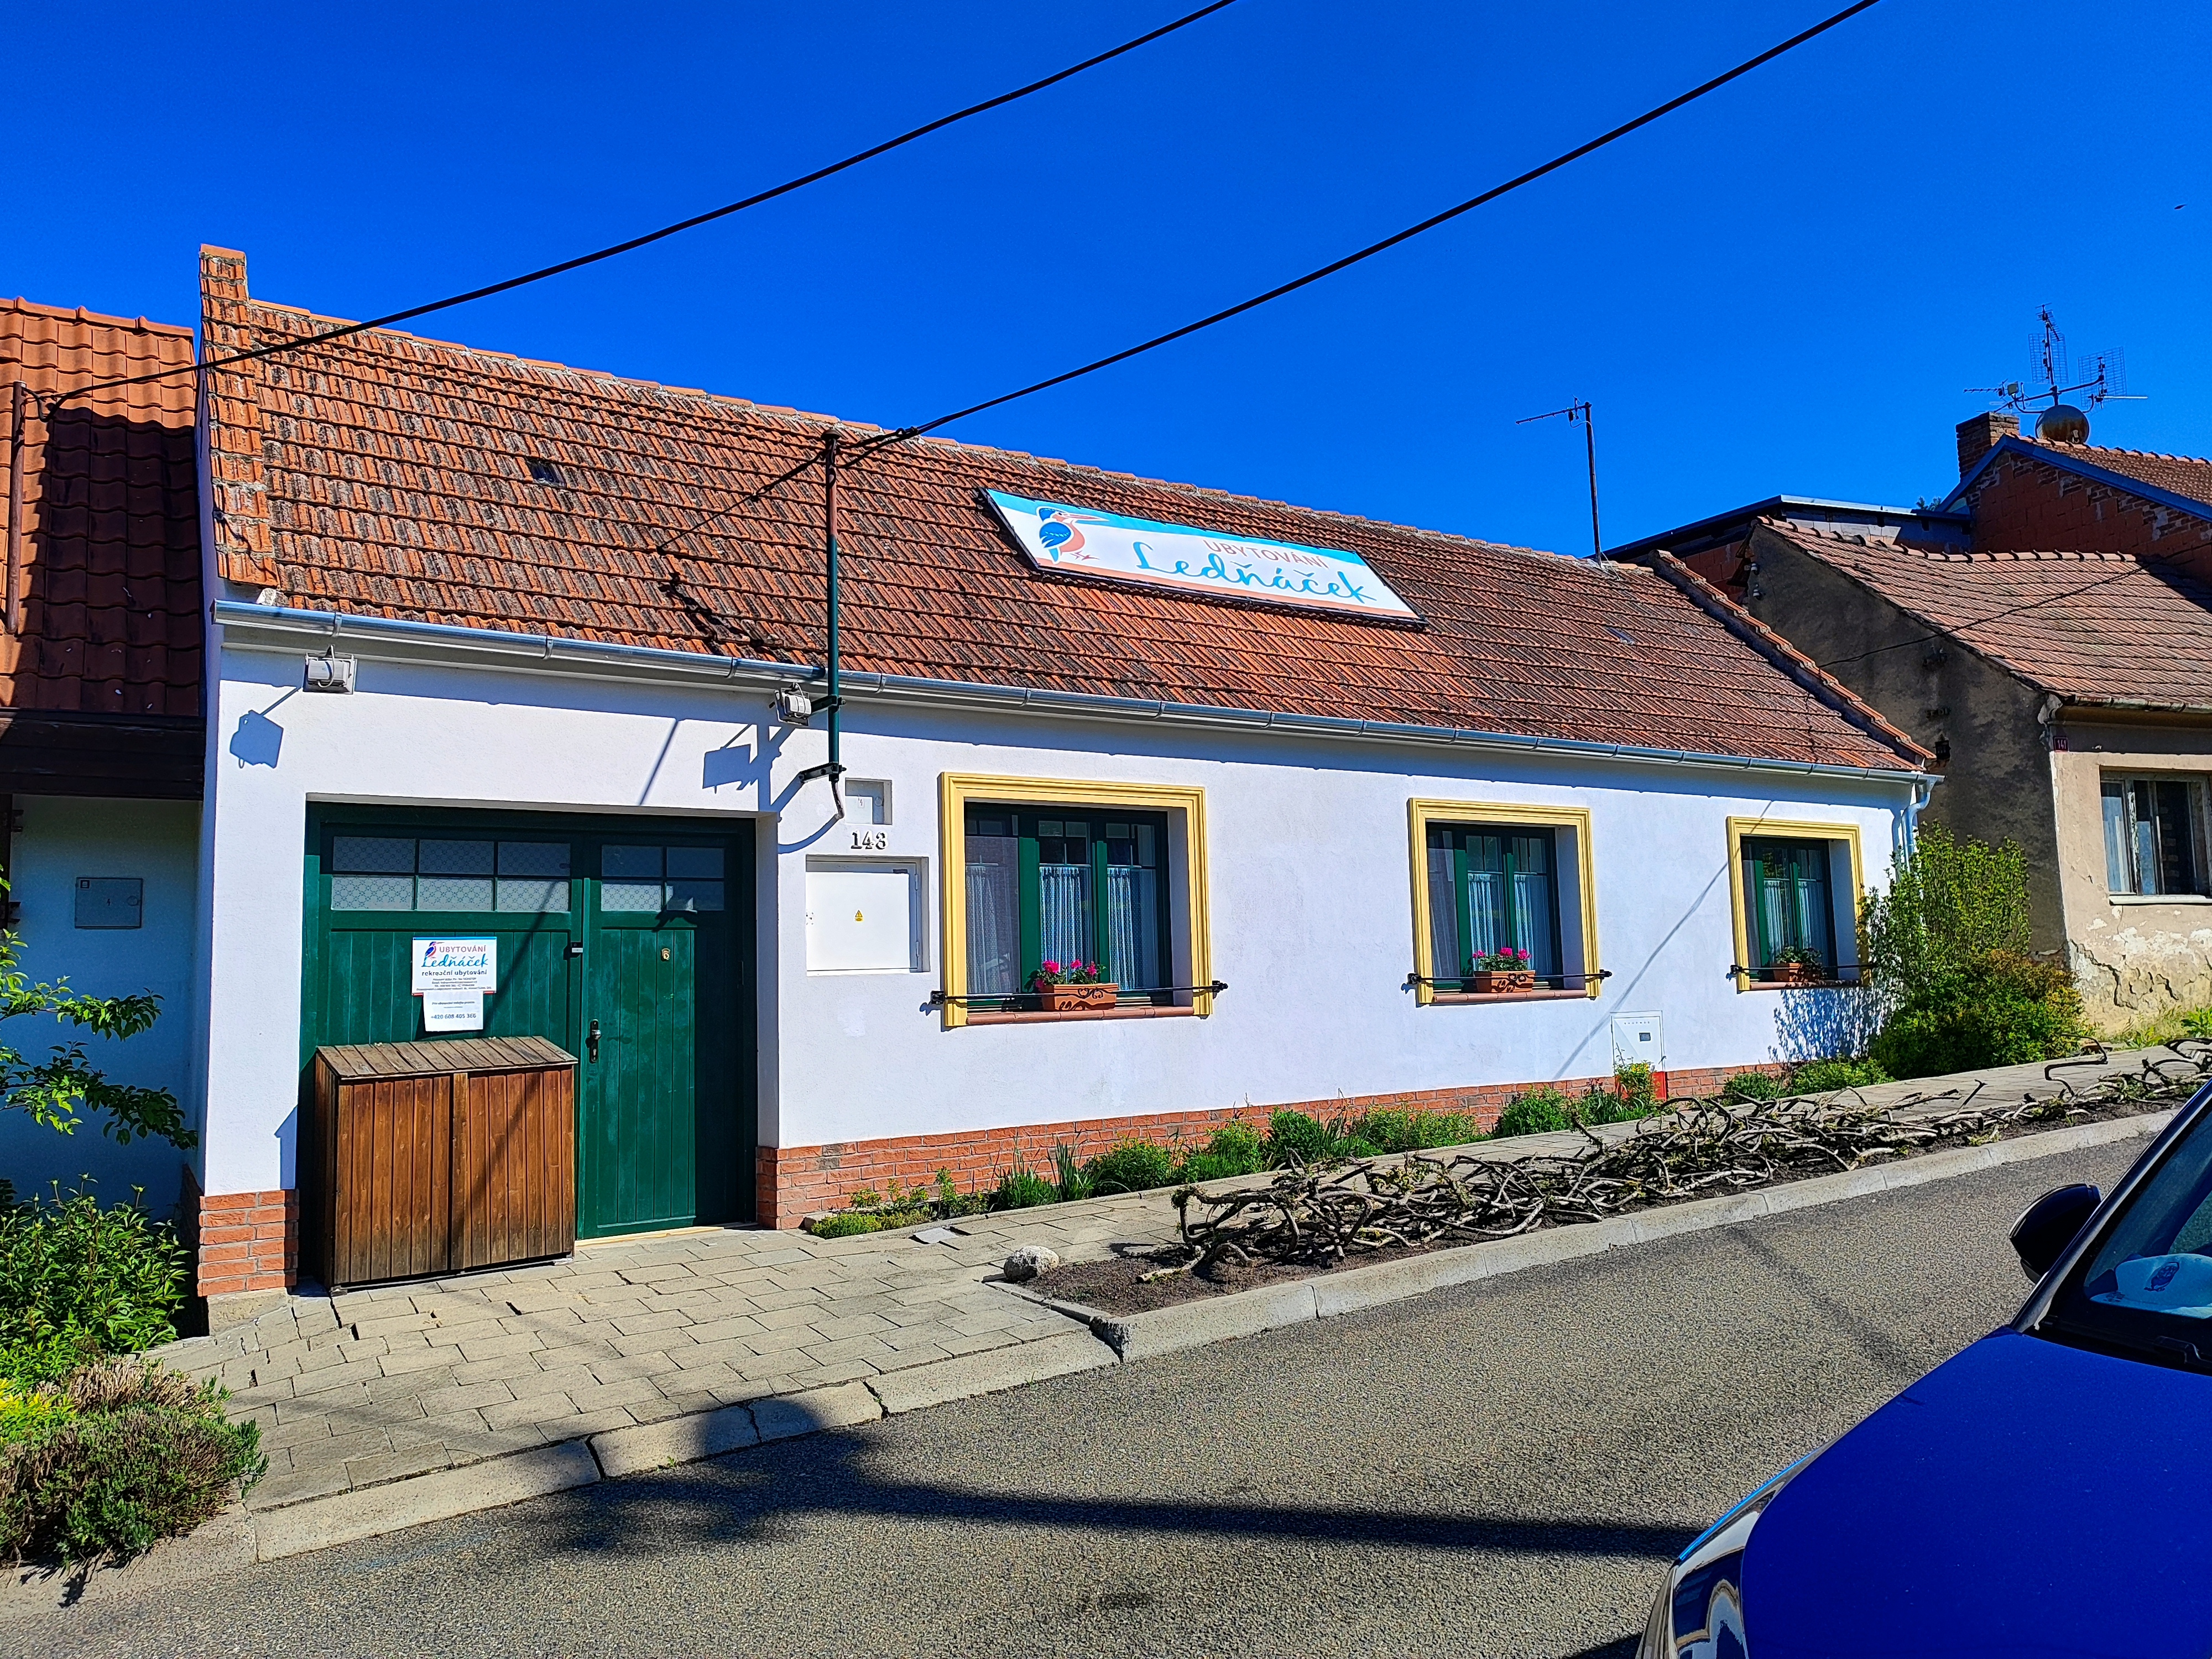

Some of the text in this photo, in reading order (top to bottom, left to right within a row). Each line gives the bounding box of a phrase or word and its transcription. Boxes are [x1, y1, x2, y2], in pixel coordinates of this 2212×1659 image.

[1203, 540, 1329, 568] UBYTOVÁNÍ
[1133, 541, 1378, 604] Ledňáček
[2057, 739, 2067, 749] 141
[421, 953, 489, 968] Ledňáček
